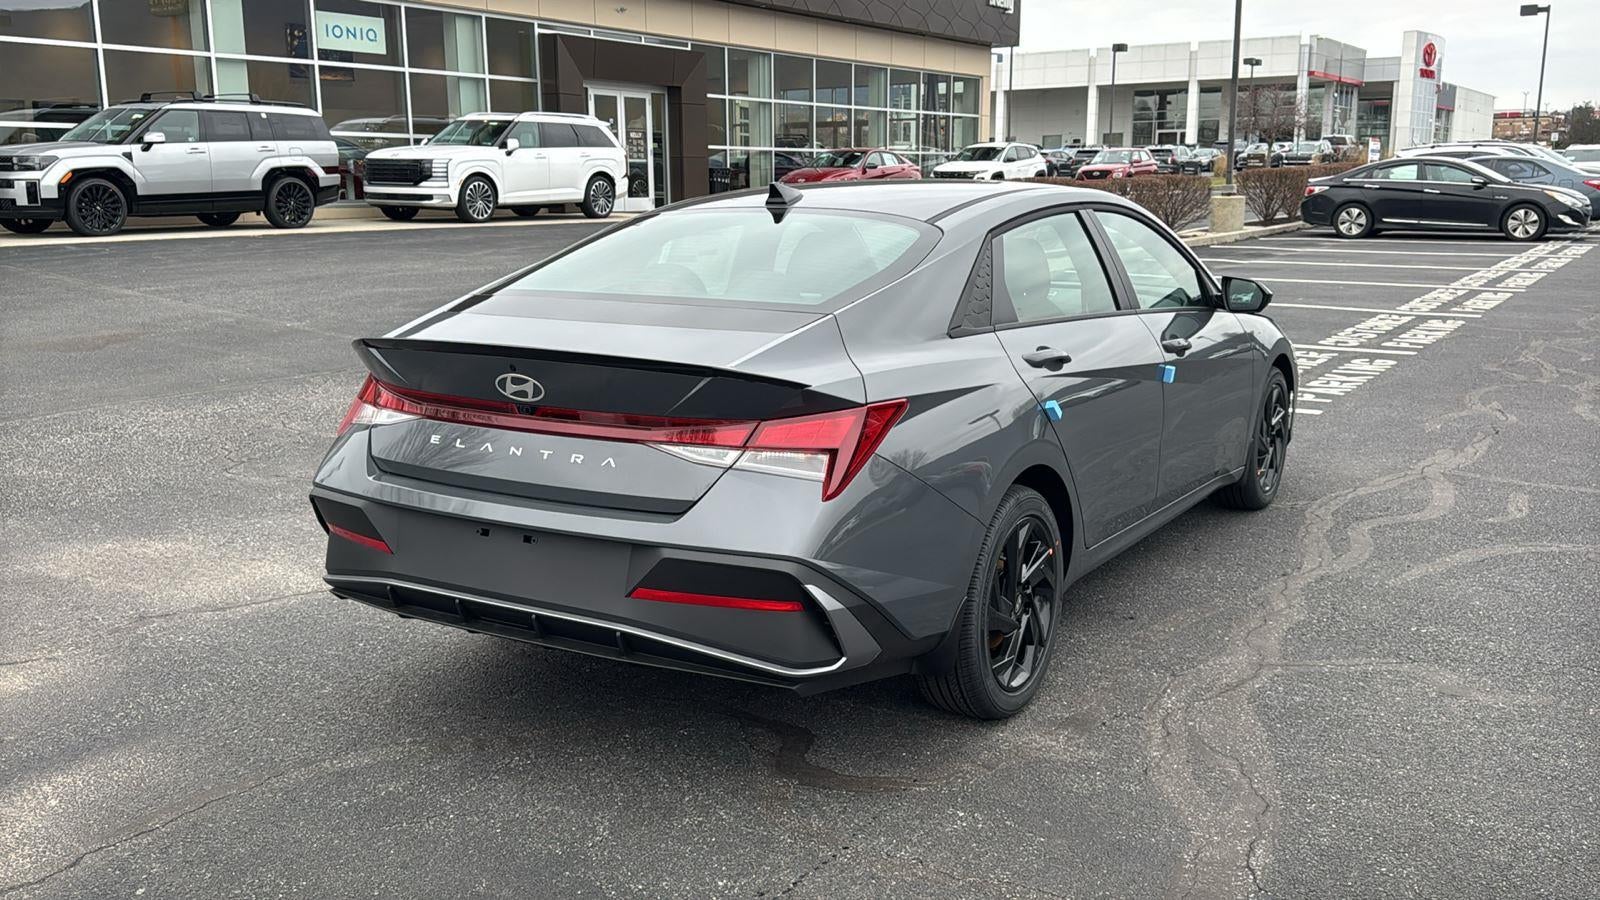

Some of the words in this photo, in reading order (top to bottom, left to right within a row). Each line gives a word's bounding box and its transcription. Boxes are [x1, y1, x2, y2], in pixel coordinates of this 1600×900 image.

[325, 23, 378, 42] IONIQ
[1381, 319, 1466, 348] PARKING
[1297, 358, 1398, 402] PARKING
[430, 434, 616, 468] ELANTRA
